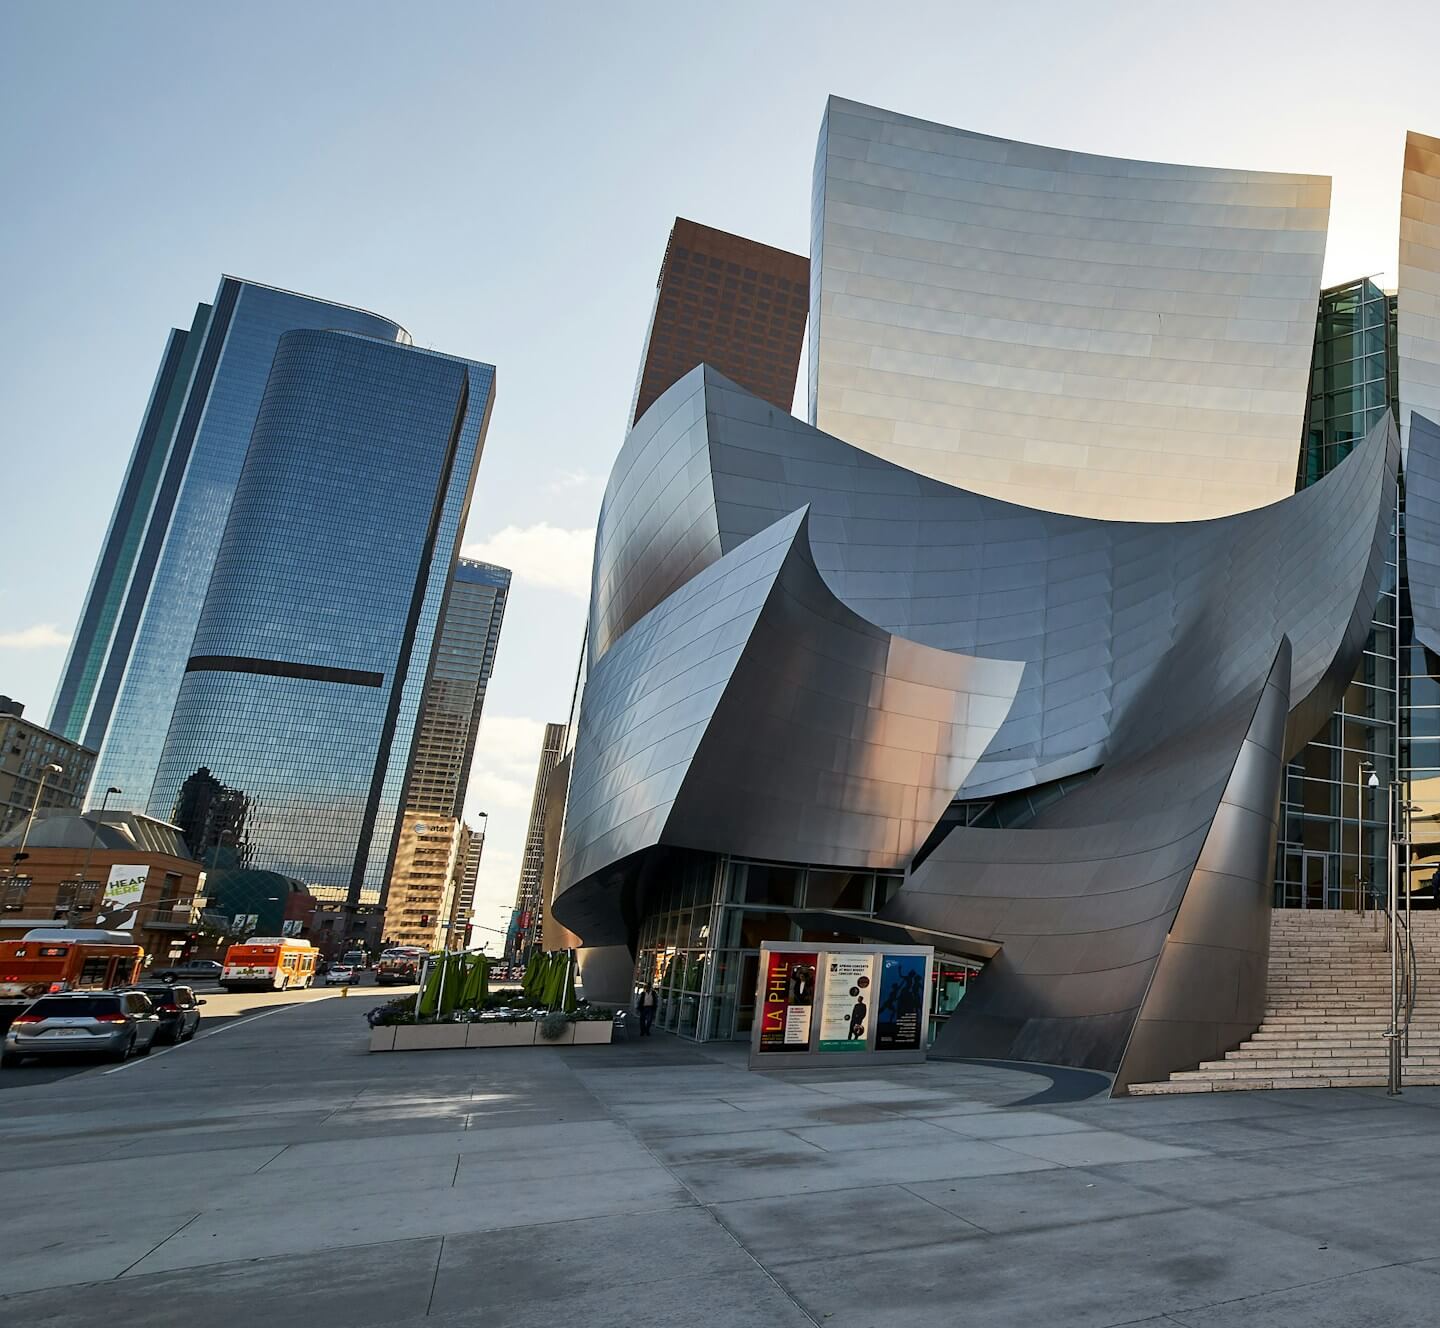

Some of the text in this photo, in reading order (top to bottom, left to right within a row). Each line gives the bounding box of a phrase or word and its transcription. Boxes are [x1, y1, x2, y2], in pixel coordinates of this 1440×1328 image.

[105, 885, 140, 897] HERE
[109, 876, 146, 889] HEAR
[769, 962, 788, 1003] PHIL
[766, 1010, 784, 1031] LA
